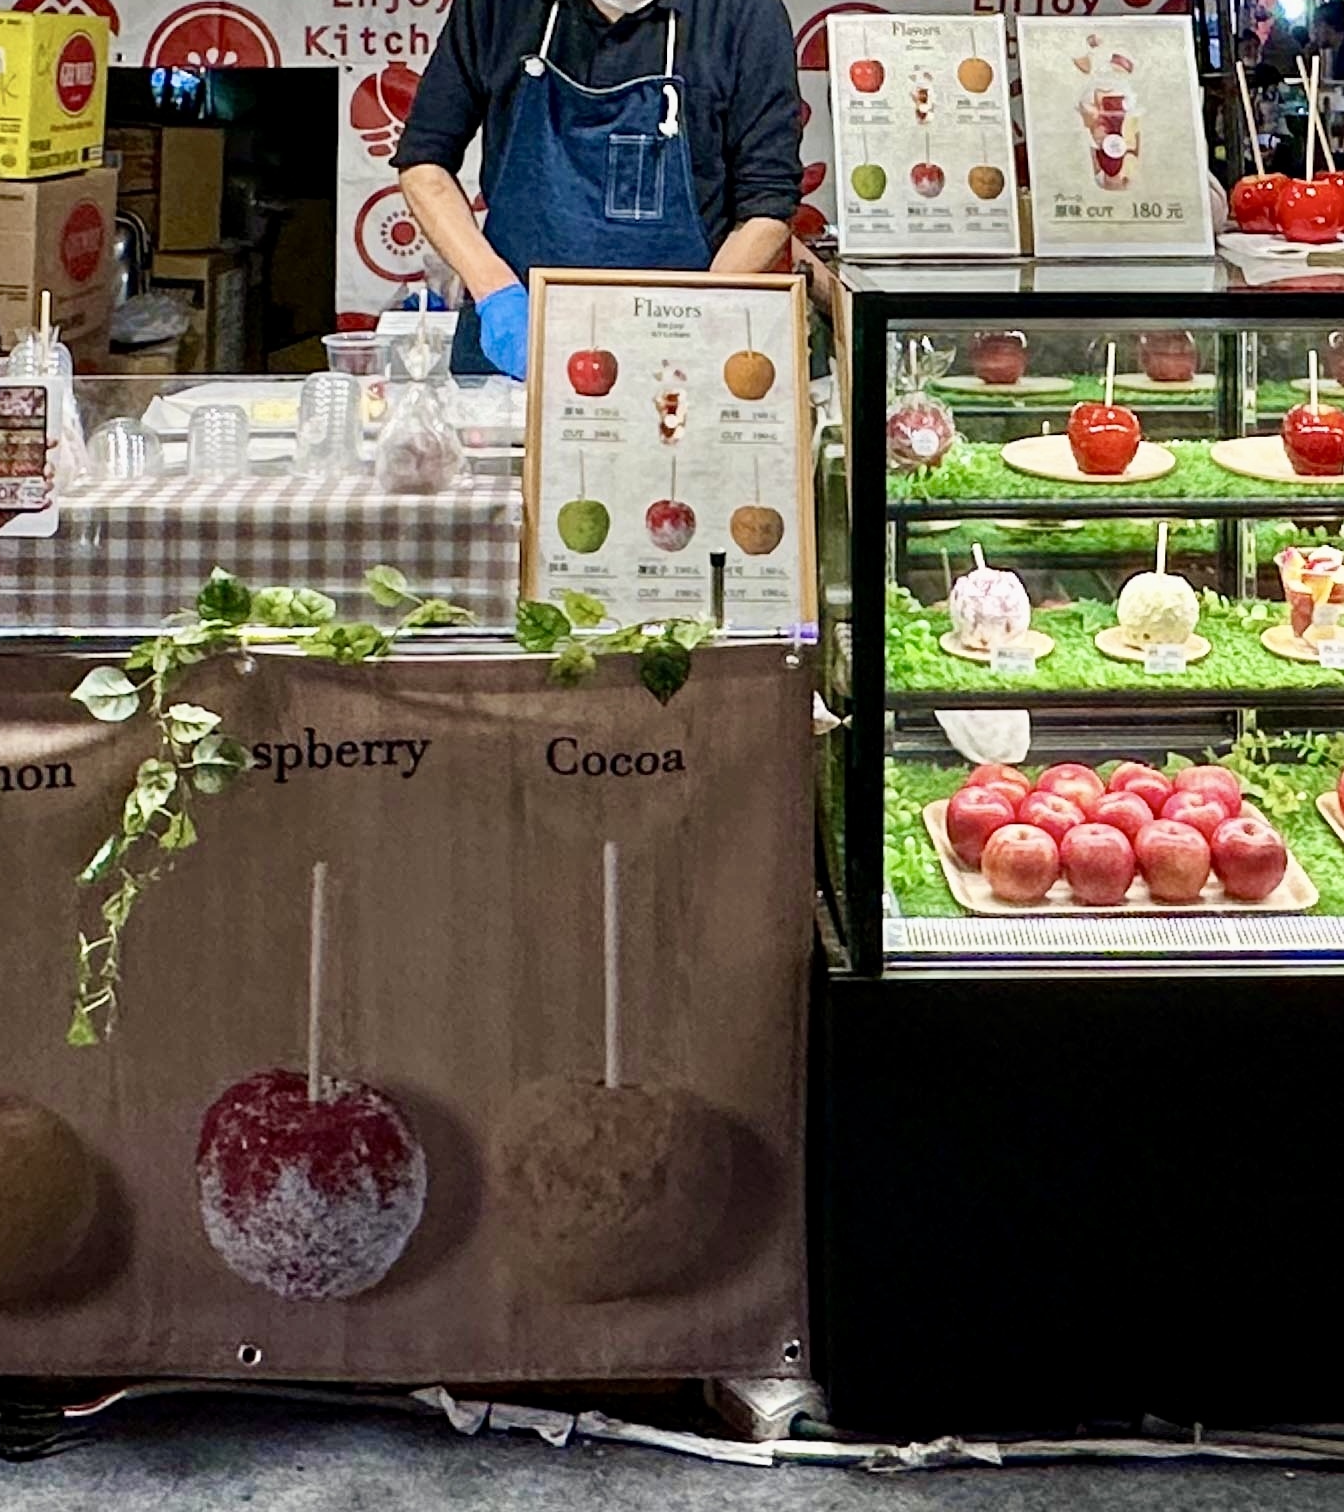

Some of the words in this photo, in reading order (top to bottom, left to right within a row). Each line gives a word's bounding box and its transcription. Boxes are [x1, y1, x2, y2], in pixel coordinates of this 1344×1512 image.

[305, 24, 429, 56] Kitch
[1087, 205, 1114, 217] CUT
[1132, 202, 1162, 218] 180
[633, 296, 703, 318] Flavors
[252, 728, 431, 783] spberry
[546, 736, 686, 777] Cocoa
